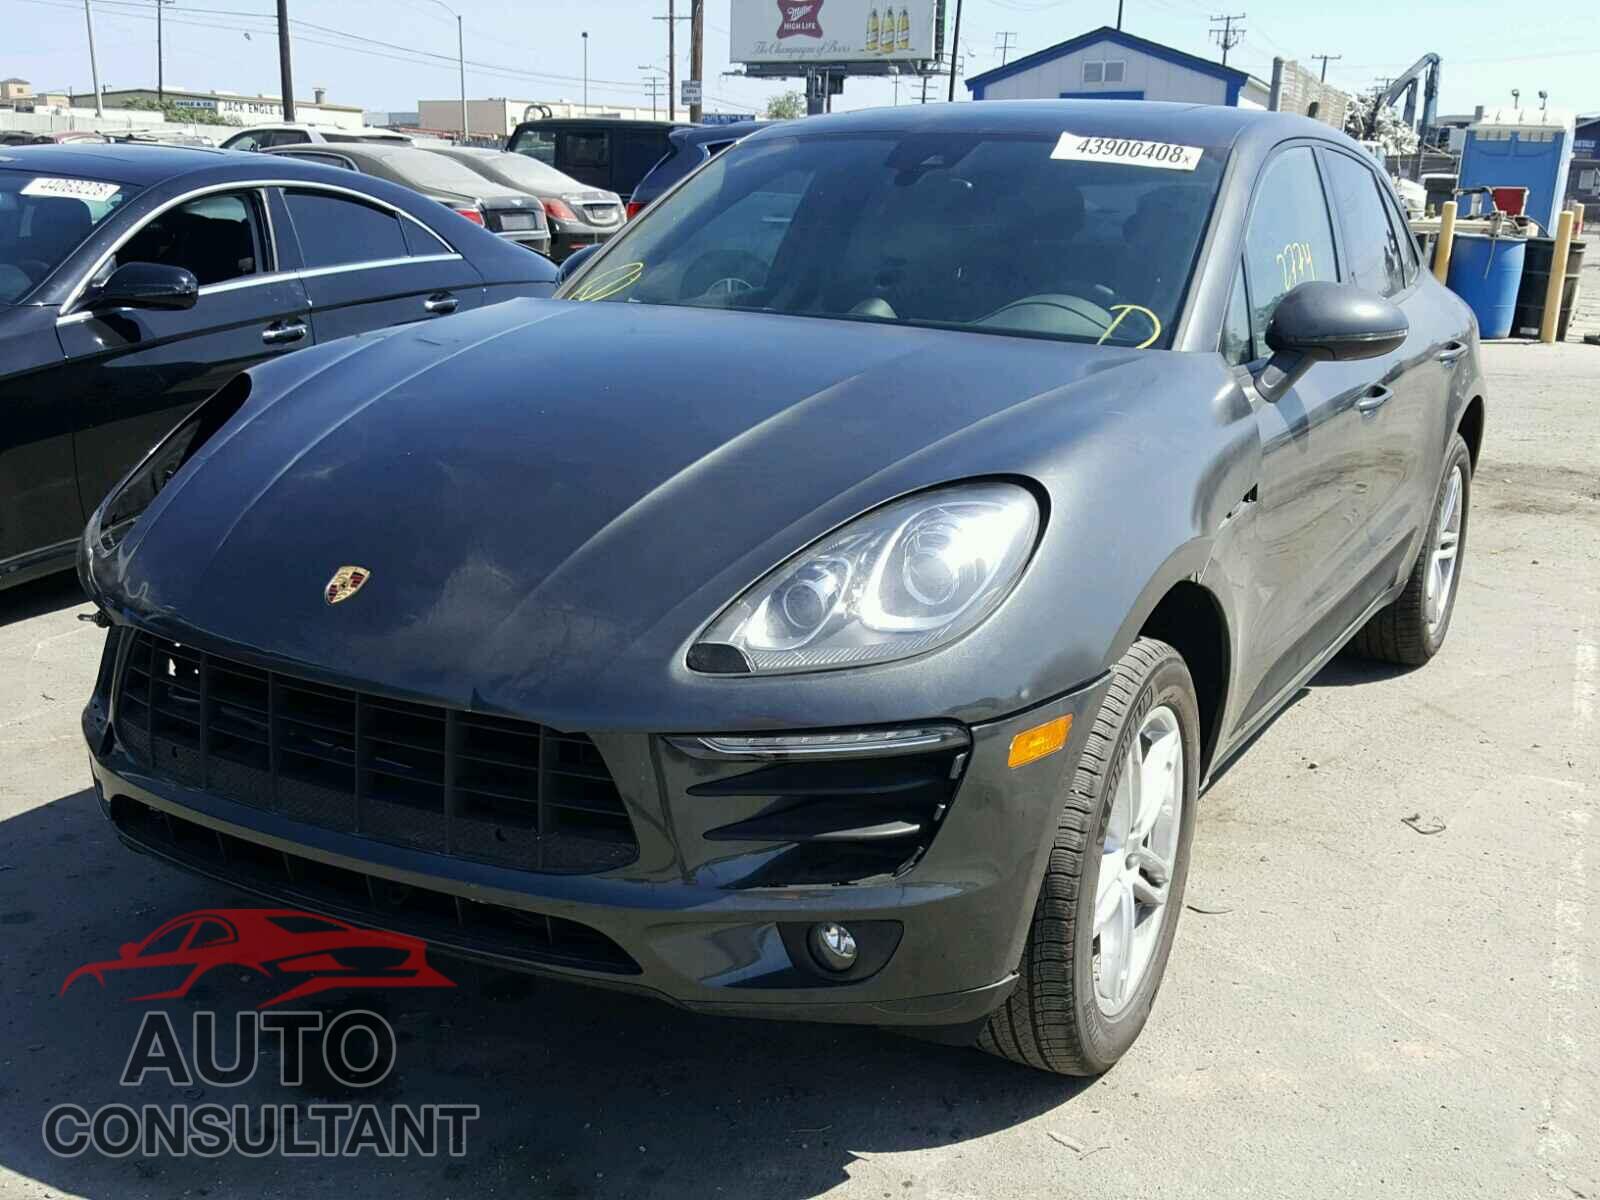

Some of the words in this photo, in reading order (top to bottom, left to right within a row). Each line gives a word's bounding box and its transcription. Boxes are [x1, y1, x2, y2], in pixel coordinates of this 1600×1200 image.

[784, 22, 801, 30] HIGH
[802, 22, 816, 30] LIFE
[223, 101, 243, 112] JACK
[248, 104, 274, 115] ENGLE
